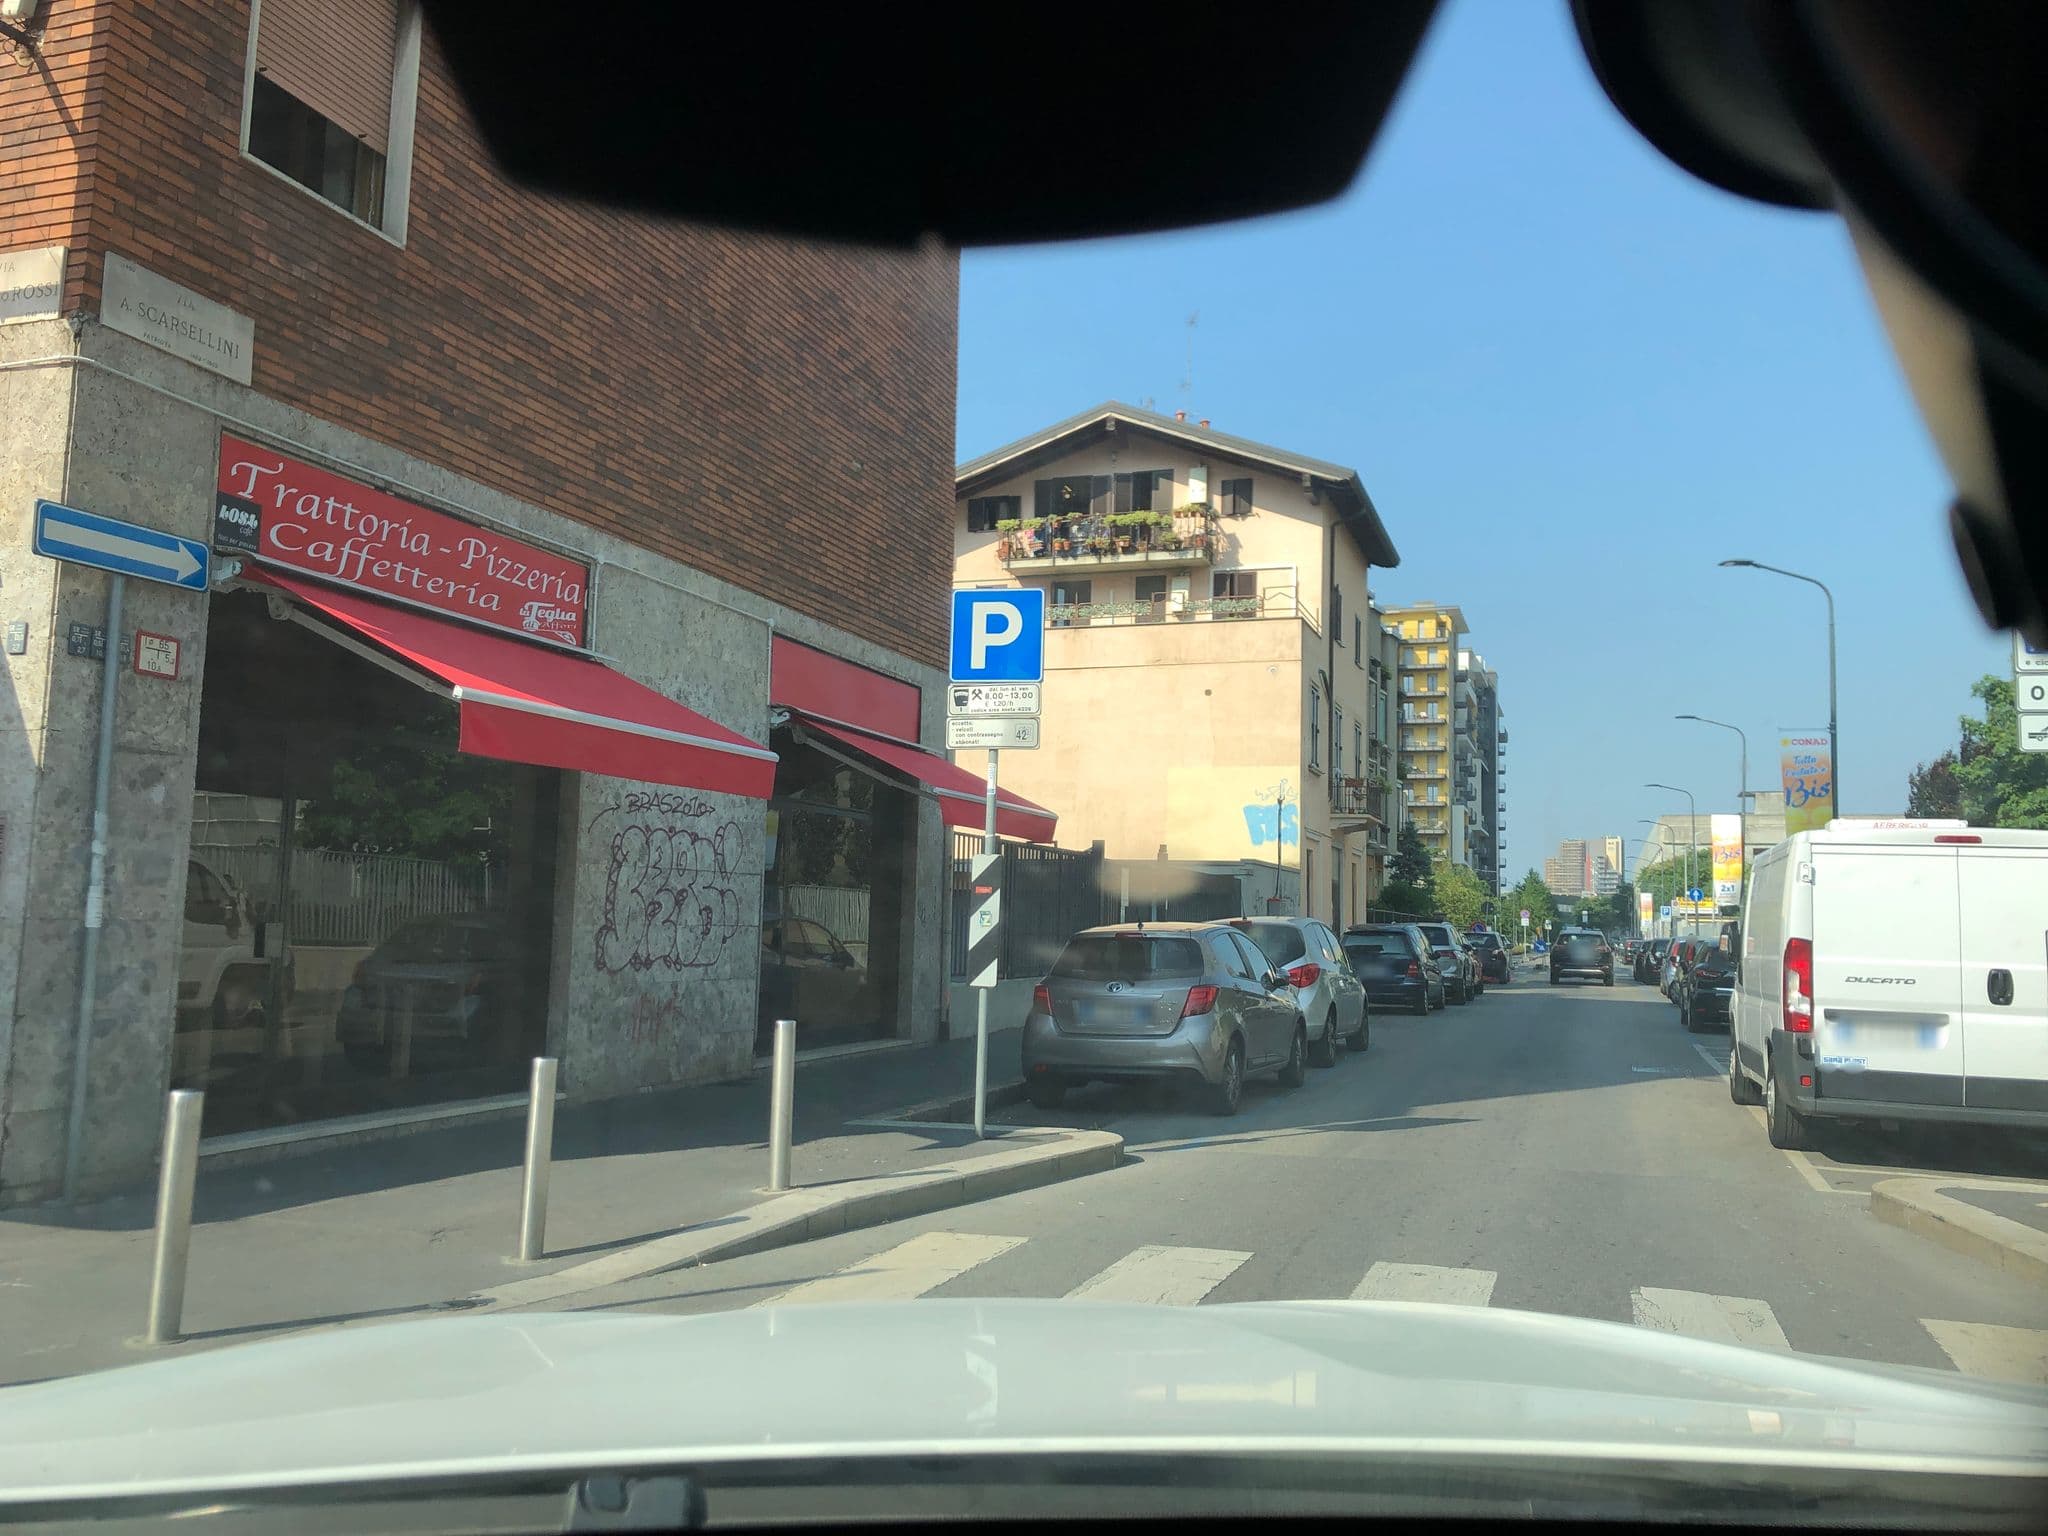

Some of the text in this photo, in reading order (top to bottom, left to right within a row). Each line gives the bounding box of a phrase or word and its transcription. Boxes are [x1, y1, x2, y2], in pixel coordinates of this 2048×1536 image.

[13, 280, 59, 302] ROSSI
[137, 301, 240, 360] SCARSELLINI
[231, 462, 431, 556] Trattoria
[458, 537, 581, 605] Pizzeria
[269, 522, 502, 611] Caffetteria
[524, 601, 577, 623] Teglia
[971, 601, 1023, 670] P
[1791, 738, 1828, 746] CONAD
[1844, 976, 1916, 985] DUCATO
